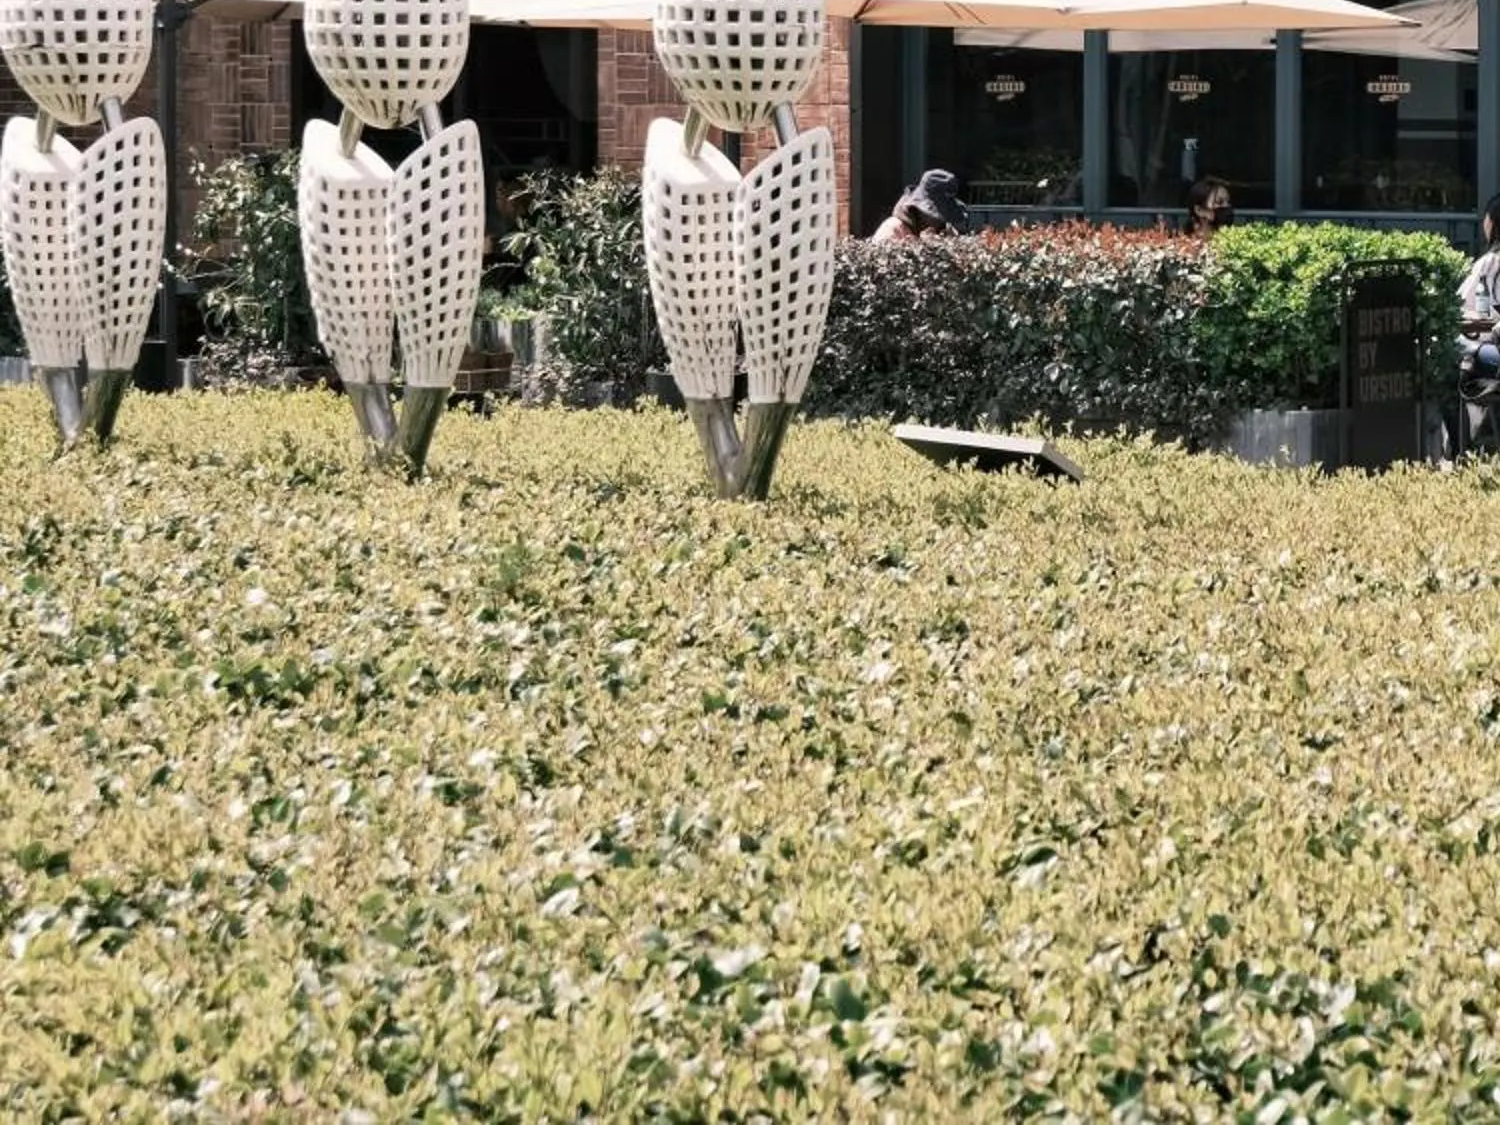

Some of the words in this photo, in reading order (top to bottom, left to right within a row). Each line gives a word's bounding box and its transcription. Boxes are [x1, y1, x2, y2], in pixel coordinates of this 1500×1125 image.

[1358, 307, 1412, 336] BISTRO
[1359, 341, 1378, 369] BY
[1359, 371, 1413, 403] URSIDE
